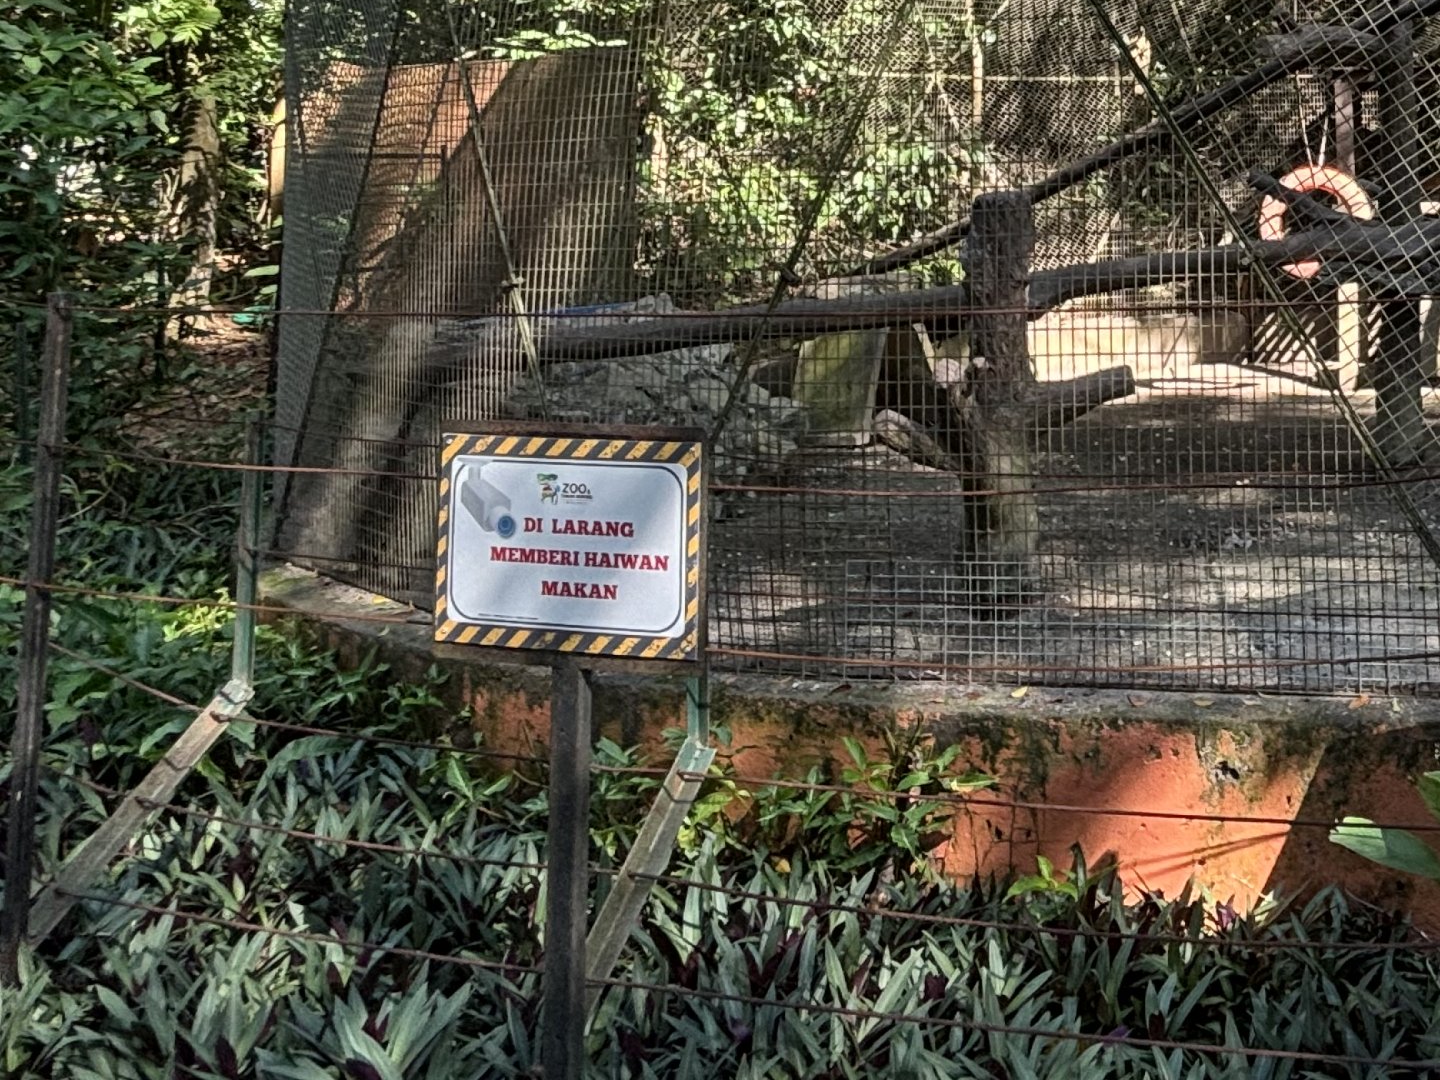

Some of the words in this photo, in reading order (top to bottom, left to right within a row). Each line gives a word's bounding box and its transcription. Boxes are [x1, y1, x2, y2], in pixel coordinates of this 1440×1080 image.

[562, 483, 587, 494] ZOO
[523, 517, 543, 533] DI
[552, 519, 635, 538] LARANG
[490, 547, 580, 567] MEMBERI
[585, 552, 669, 571] HAIWAN
[541, 581, 618, 600] MAKAN
